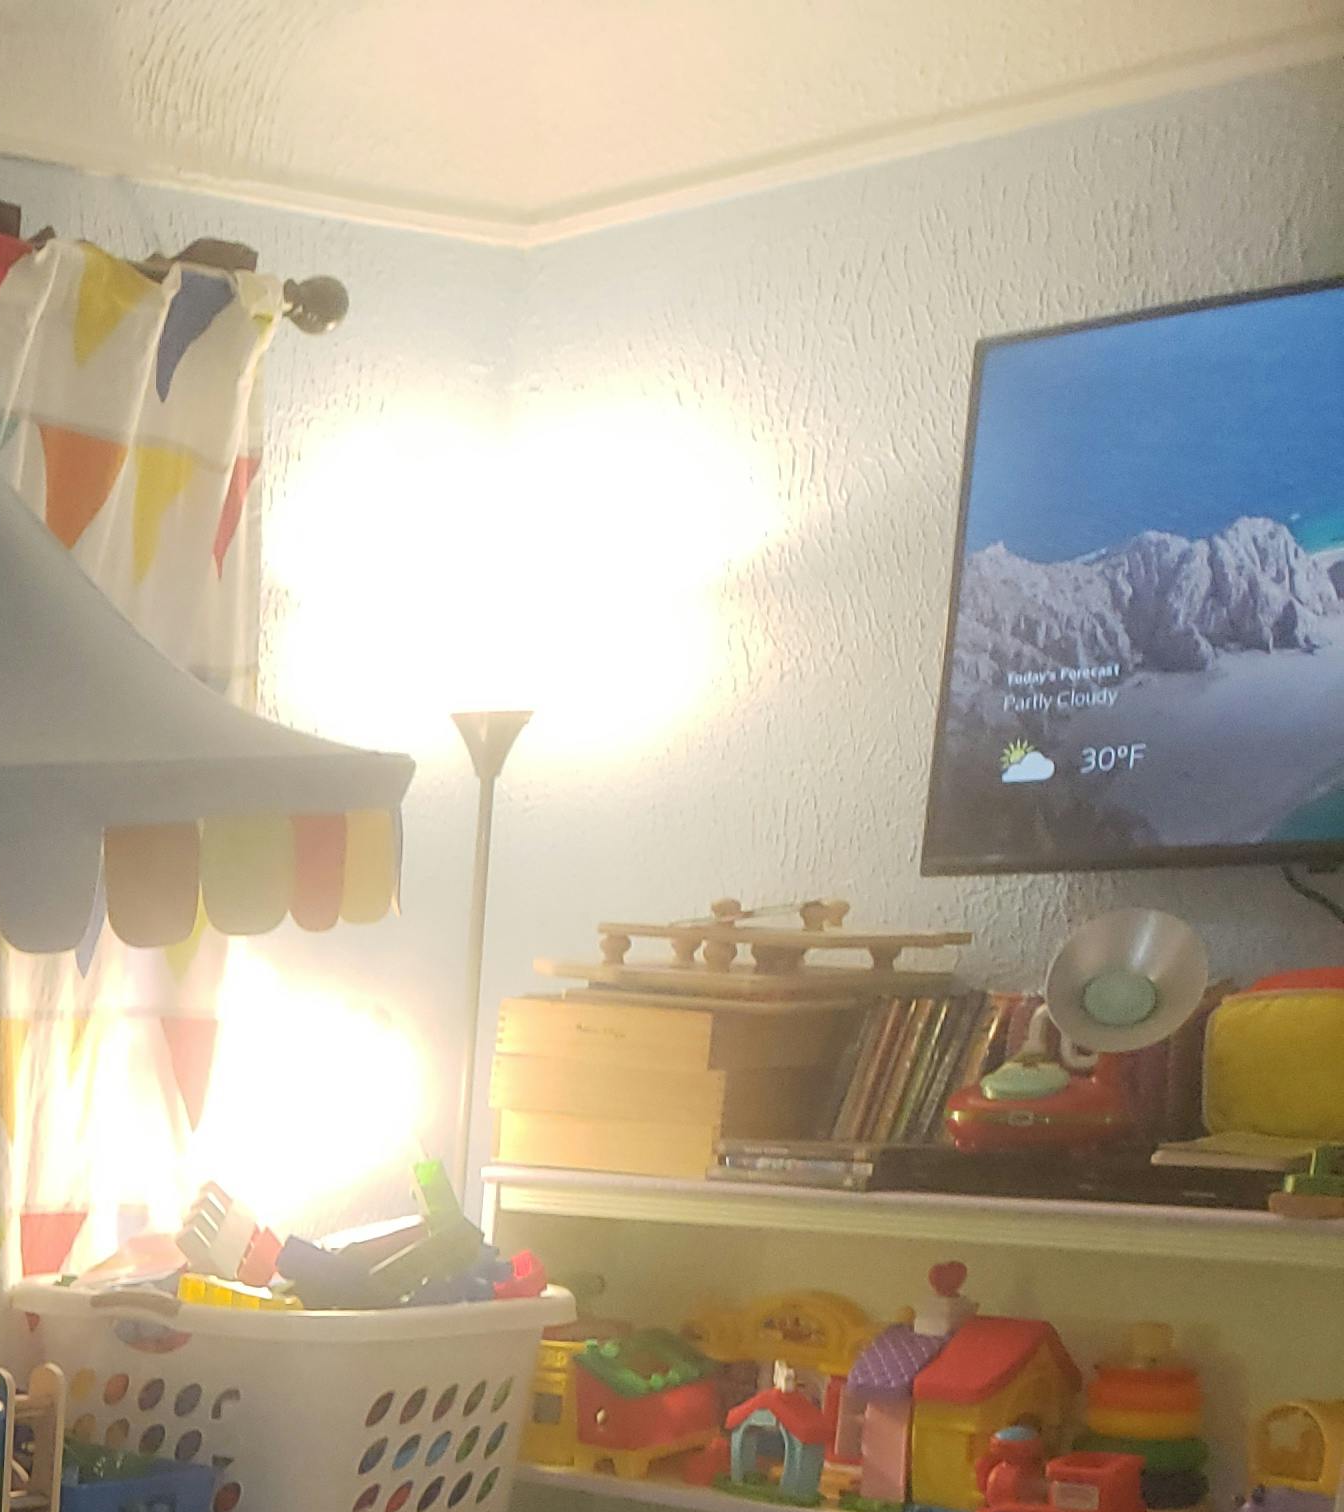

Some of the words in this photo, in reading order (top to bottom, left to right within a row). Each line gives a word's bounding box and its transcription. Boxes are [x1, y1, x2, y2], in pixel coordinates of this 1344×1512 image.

[1060, 663, 1121, 682] Forecast
[1003, 692, 1054, 713] Partly
[1057, 687, 1119, 708] Cloudy
